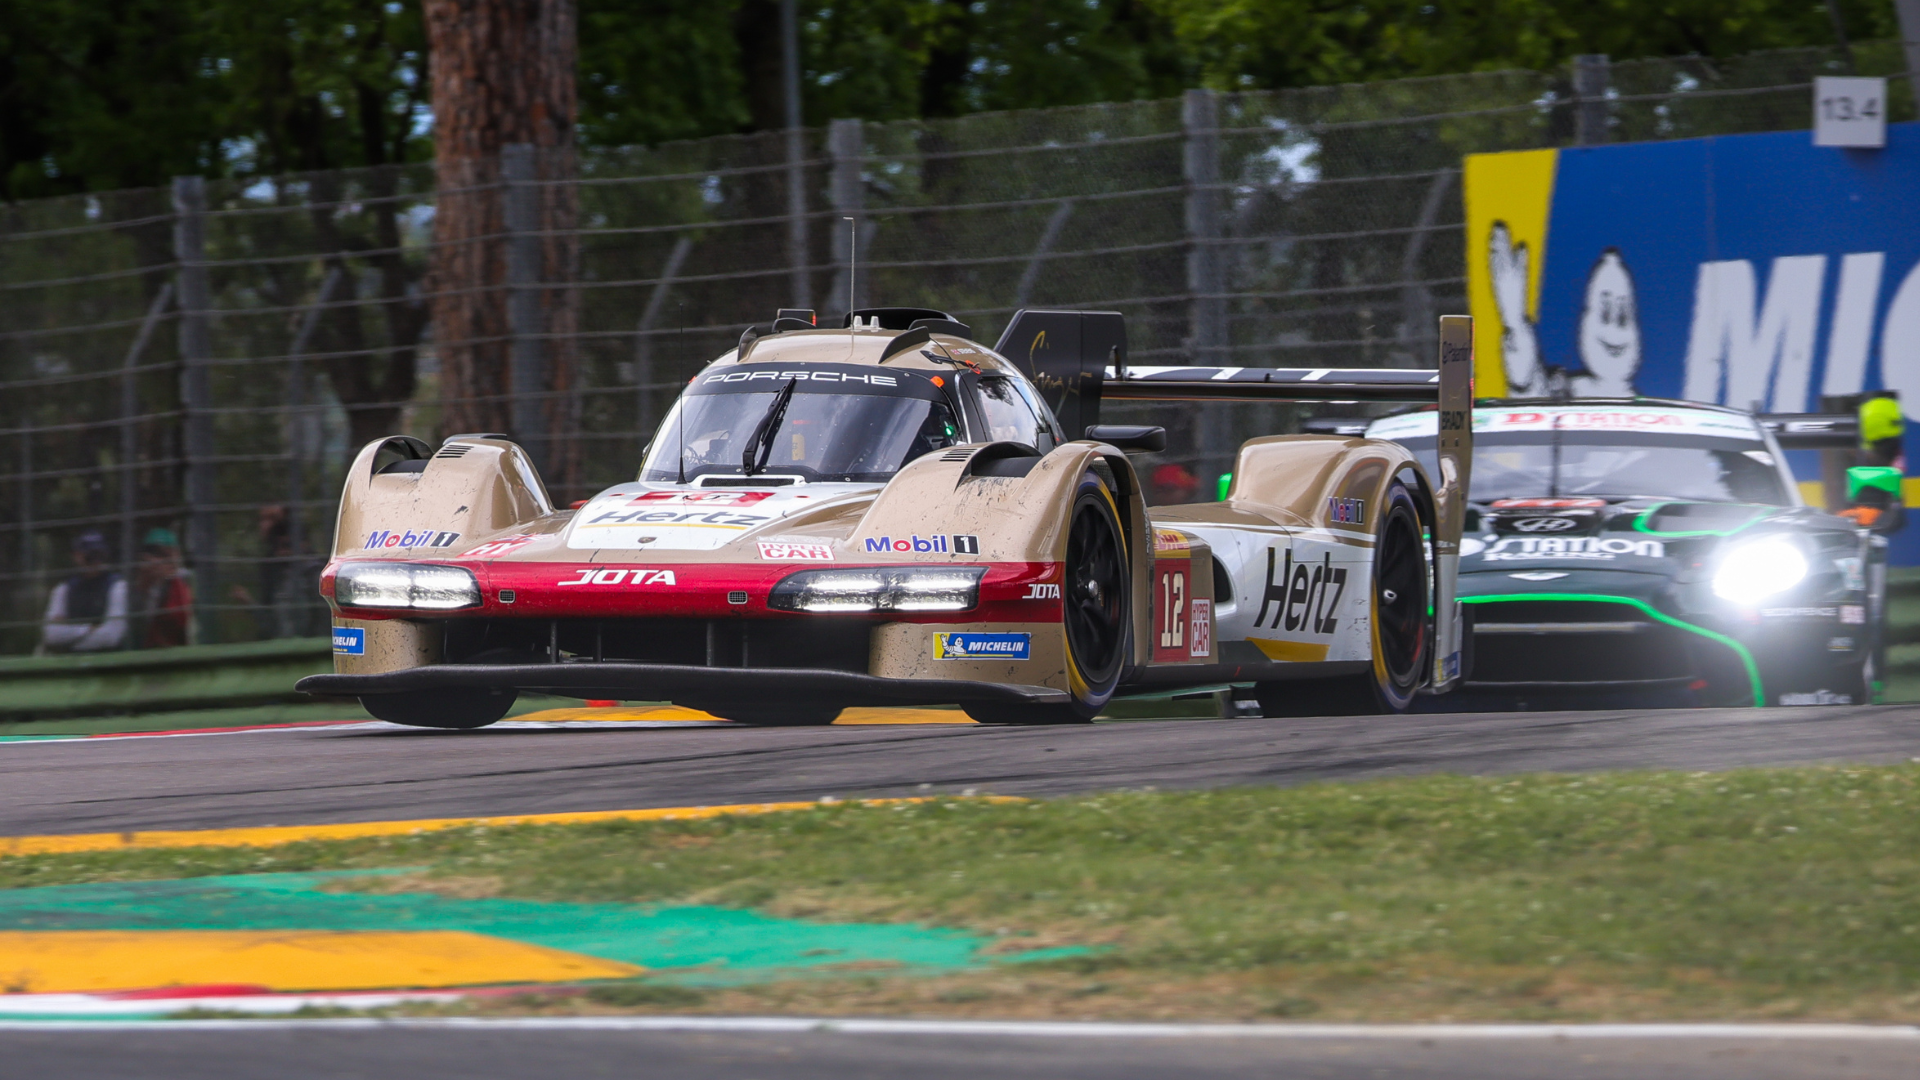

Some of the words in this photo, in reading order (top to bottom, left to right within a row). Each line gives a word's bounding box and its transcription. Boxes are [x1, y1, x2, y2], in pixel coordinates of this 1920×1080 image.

[1820, 96, 1878, 121] 13.4
[702, 371, 897, 387] PORSCHE
[587, 510, 772, 525] Hertz
[364, 530, 433, 549] Mobil
[761, 543, 824, 551] HYPER
[864, 535, 948, 552] Mobil
[764, 549, 829, 558] CAR
[558, 570, 676, 585] JOTA
[1022, 583, 1060, 599] JOTA
[1253, 547, 1347, 634] Hertz
[1161, 571, 1185, 649] 12
[1192, 621, 1209, 653] CAR
[967, 641, 1024, 651] MICHELIN
